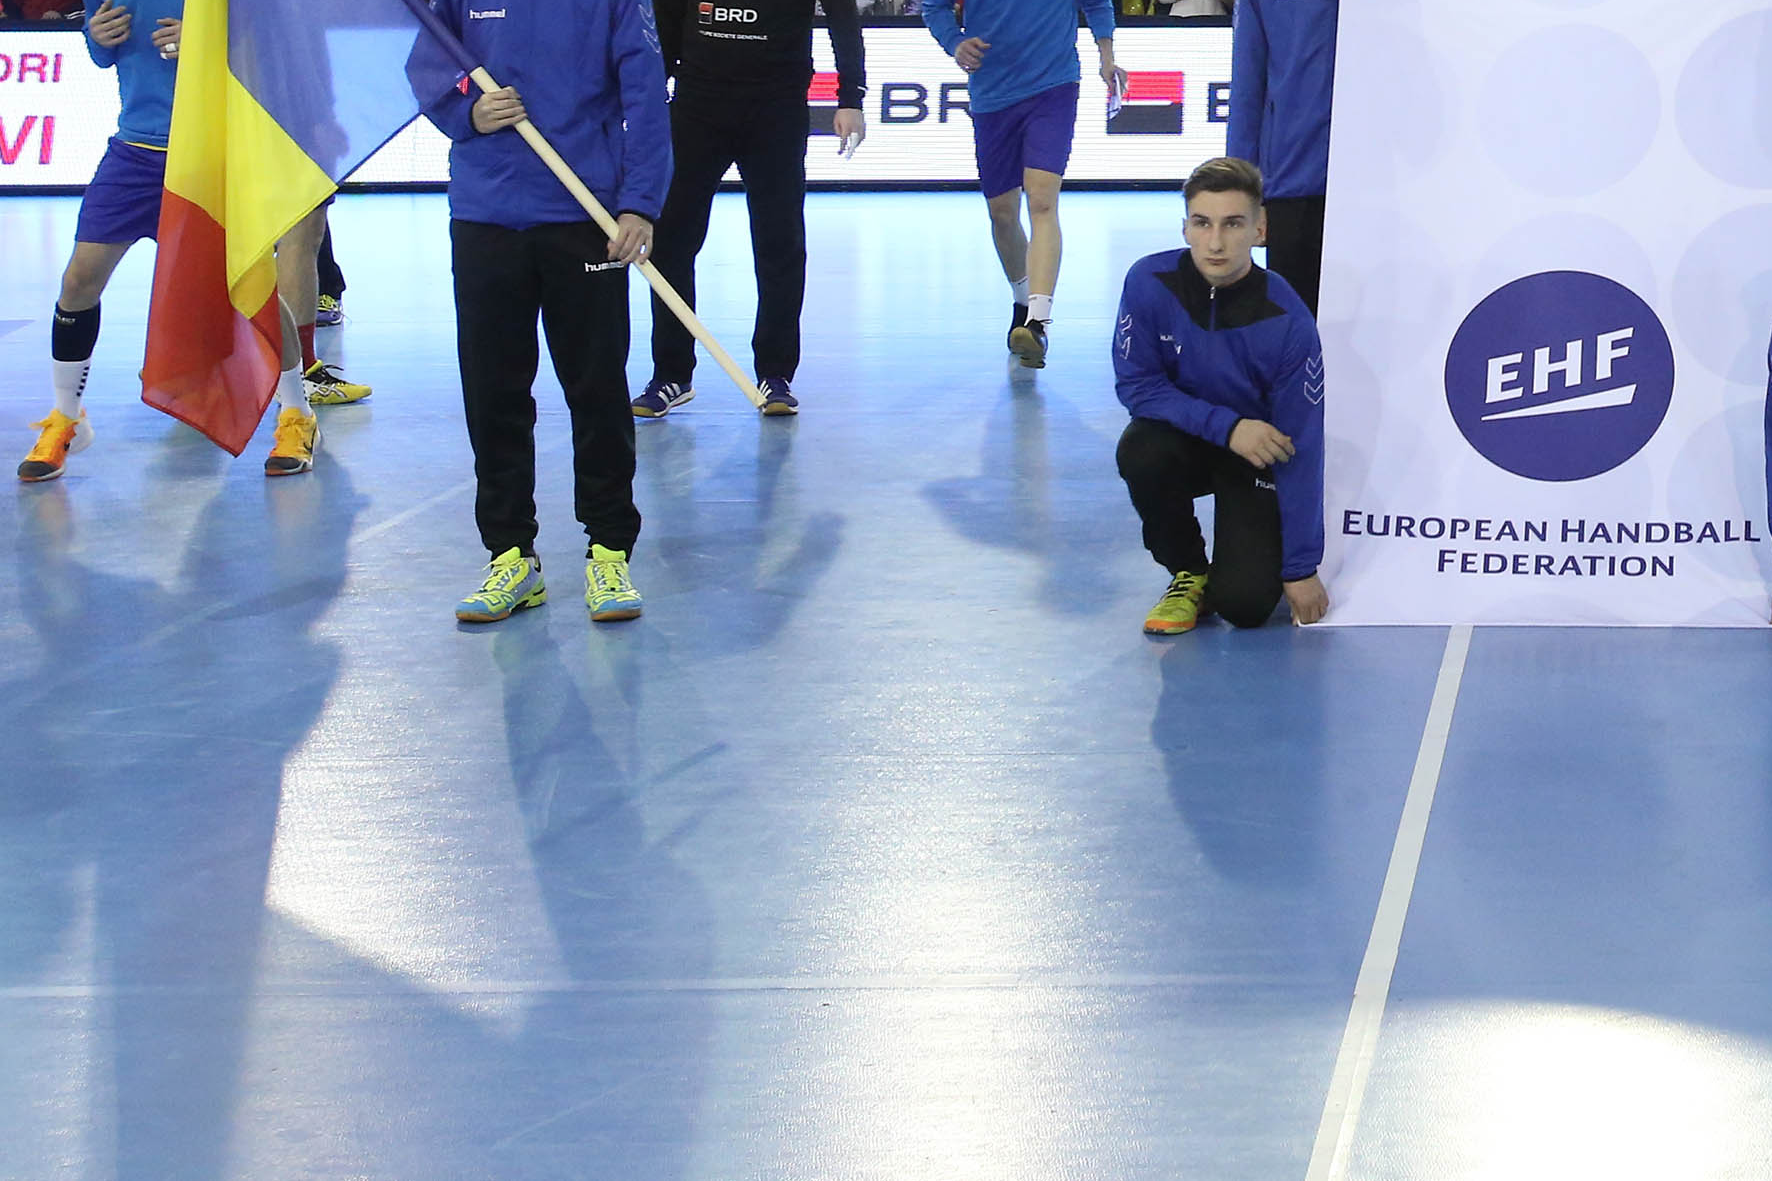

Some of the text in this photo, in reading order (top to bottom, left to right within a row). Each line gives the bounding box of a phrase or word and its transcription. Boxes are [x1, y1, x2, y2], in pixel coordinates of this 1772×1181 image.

[714, 7, 758, 23] BRD
[1485, 327, 1634, 404] EHF
[1342, 510, 1761, 544] EUROPEAN HANDBALL
[1437, 549, 1675, 577] FEDERATION
